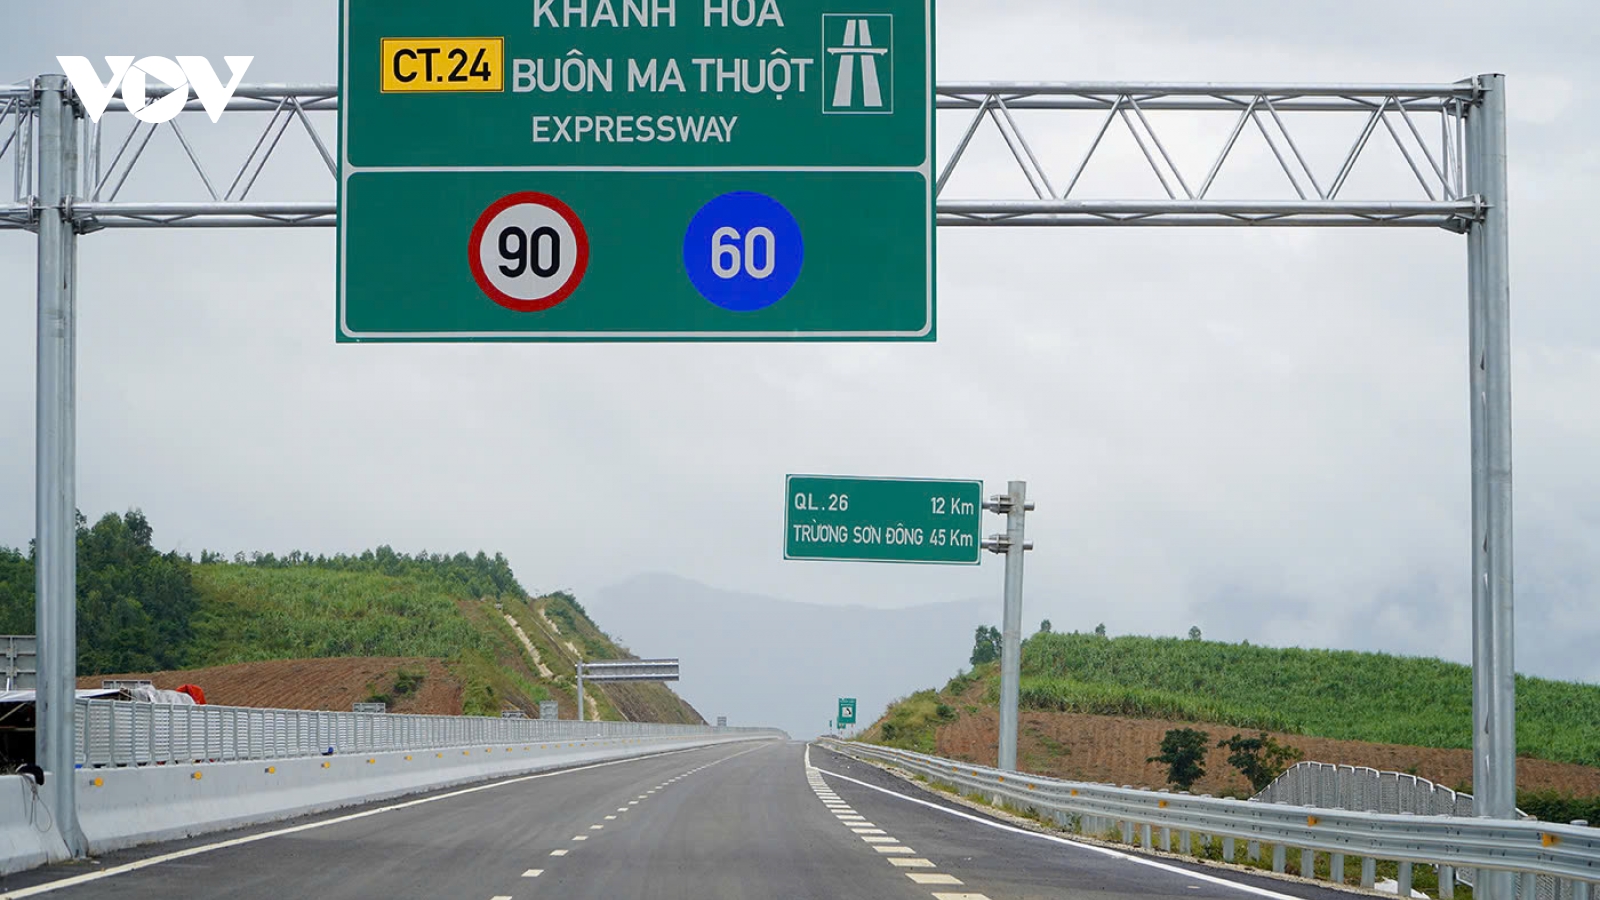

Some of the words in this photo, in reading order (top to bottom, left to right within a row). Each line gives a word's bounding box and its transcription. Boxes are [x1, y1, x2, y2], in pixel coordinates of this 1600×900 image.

[392, 49, 492, 83] CT.24
[512, 49, 613, 93] BUÔN
[627, 58, 687, 92] MA
[692, 48, 814, 100] THUỘT
[532, 115, 738, 143] EXPRESSWAY
[498, 226, 561, 278] 90
[710, 226, 776, 279] 60
[930, 496, 946, 514] 12
[951, 497, 974, 515] Km
[853, 524, 881, 544] SƠN
[885, 522, 924, 545] ĐÔNG
[929, 528, 946, 546] 45
[950, 529, 973, 547] Km
